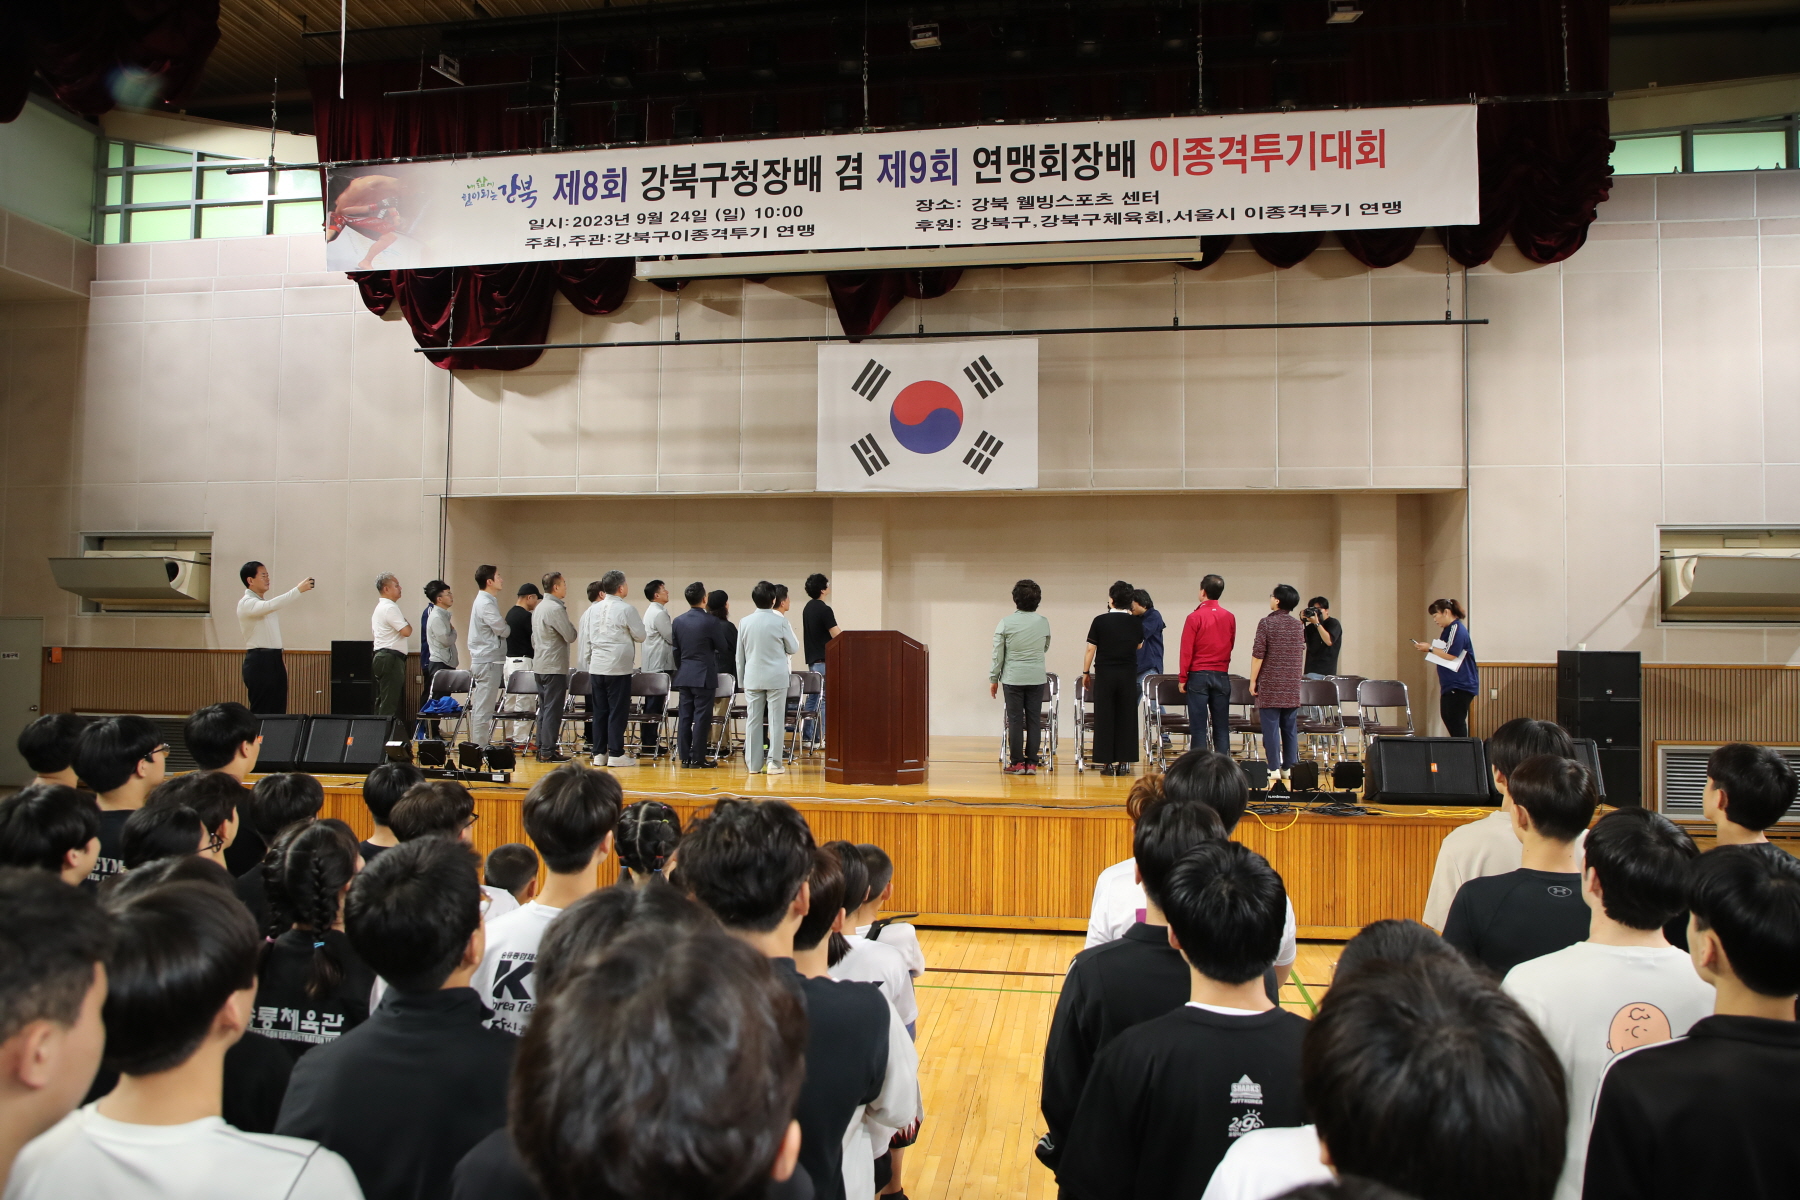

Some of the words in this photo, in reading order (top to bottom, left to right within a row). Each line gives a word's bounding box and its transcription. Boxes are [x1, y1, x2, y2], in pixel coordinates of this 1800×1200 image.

[552, 166, 628, 206] 제8회
[640, 154, 823, 202] 강북구청장배
[834, 151, 864, 192] 겸
[876, 147, 959, 189] 제9회
[972, 139, 1137, 185] 연맹회장배
[1149, 128, 1387, 177] 이종격투기대회
[497, 173, 538, 209] 강북
[915, 198, 963, 213] 장소:
[971, 196, 1010, 212] 강북
[1016, 192, 1115, 211] 웰빙스포츠
[1121, 189, 1160, 206] 센터
[636, 211, 663, 226] 9월
[669, 208, 708, 224] 24일
[715, 206, 747, 222] (일)
[754, 204, 804, 219] 10:00
[914, 218, 963, 233] 후원:
[1244, 202, 1351, 220] 이종격투기
[1359, 200, 1403, 216] 연맹
[776, 223, 816, 238] 연맹
[493, 1000, 515, 1012] orea
[517, 1001, 538, 1013] Tea
